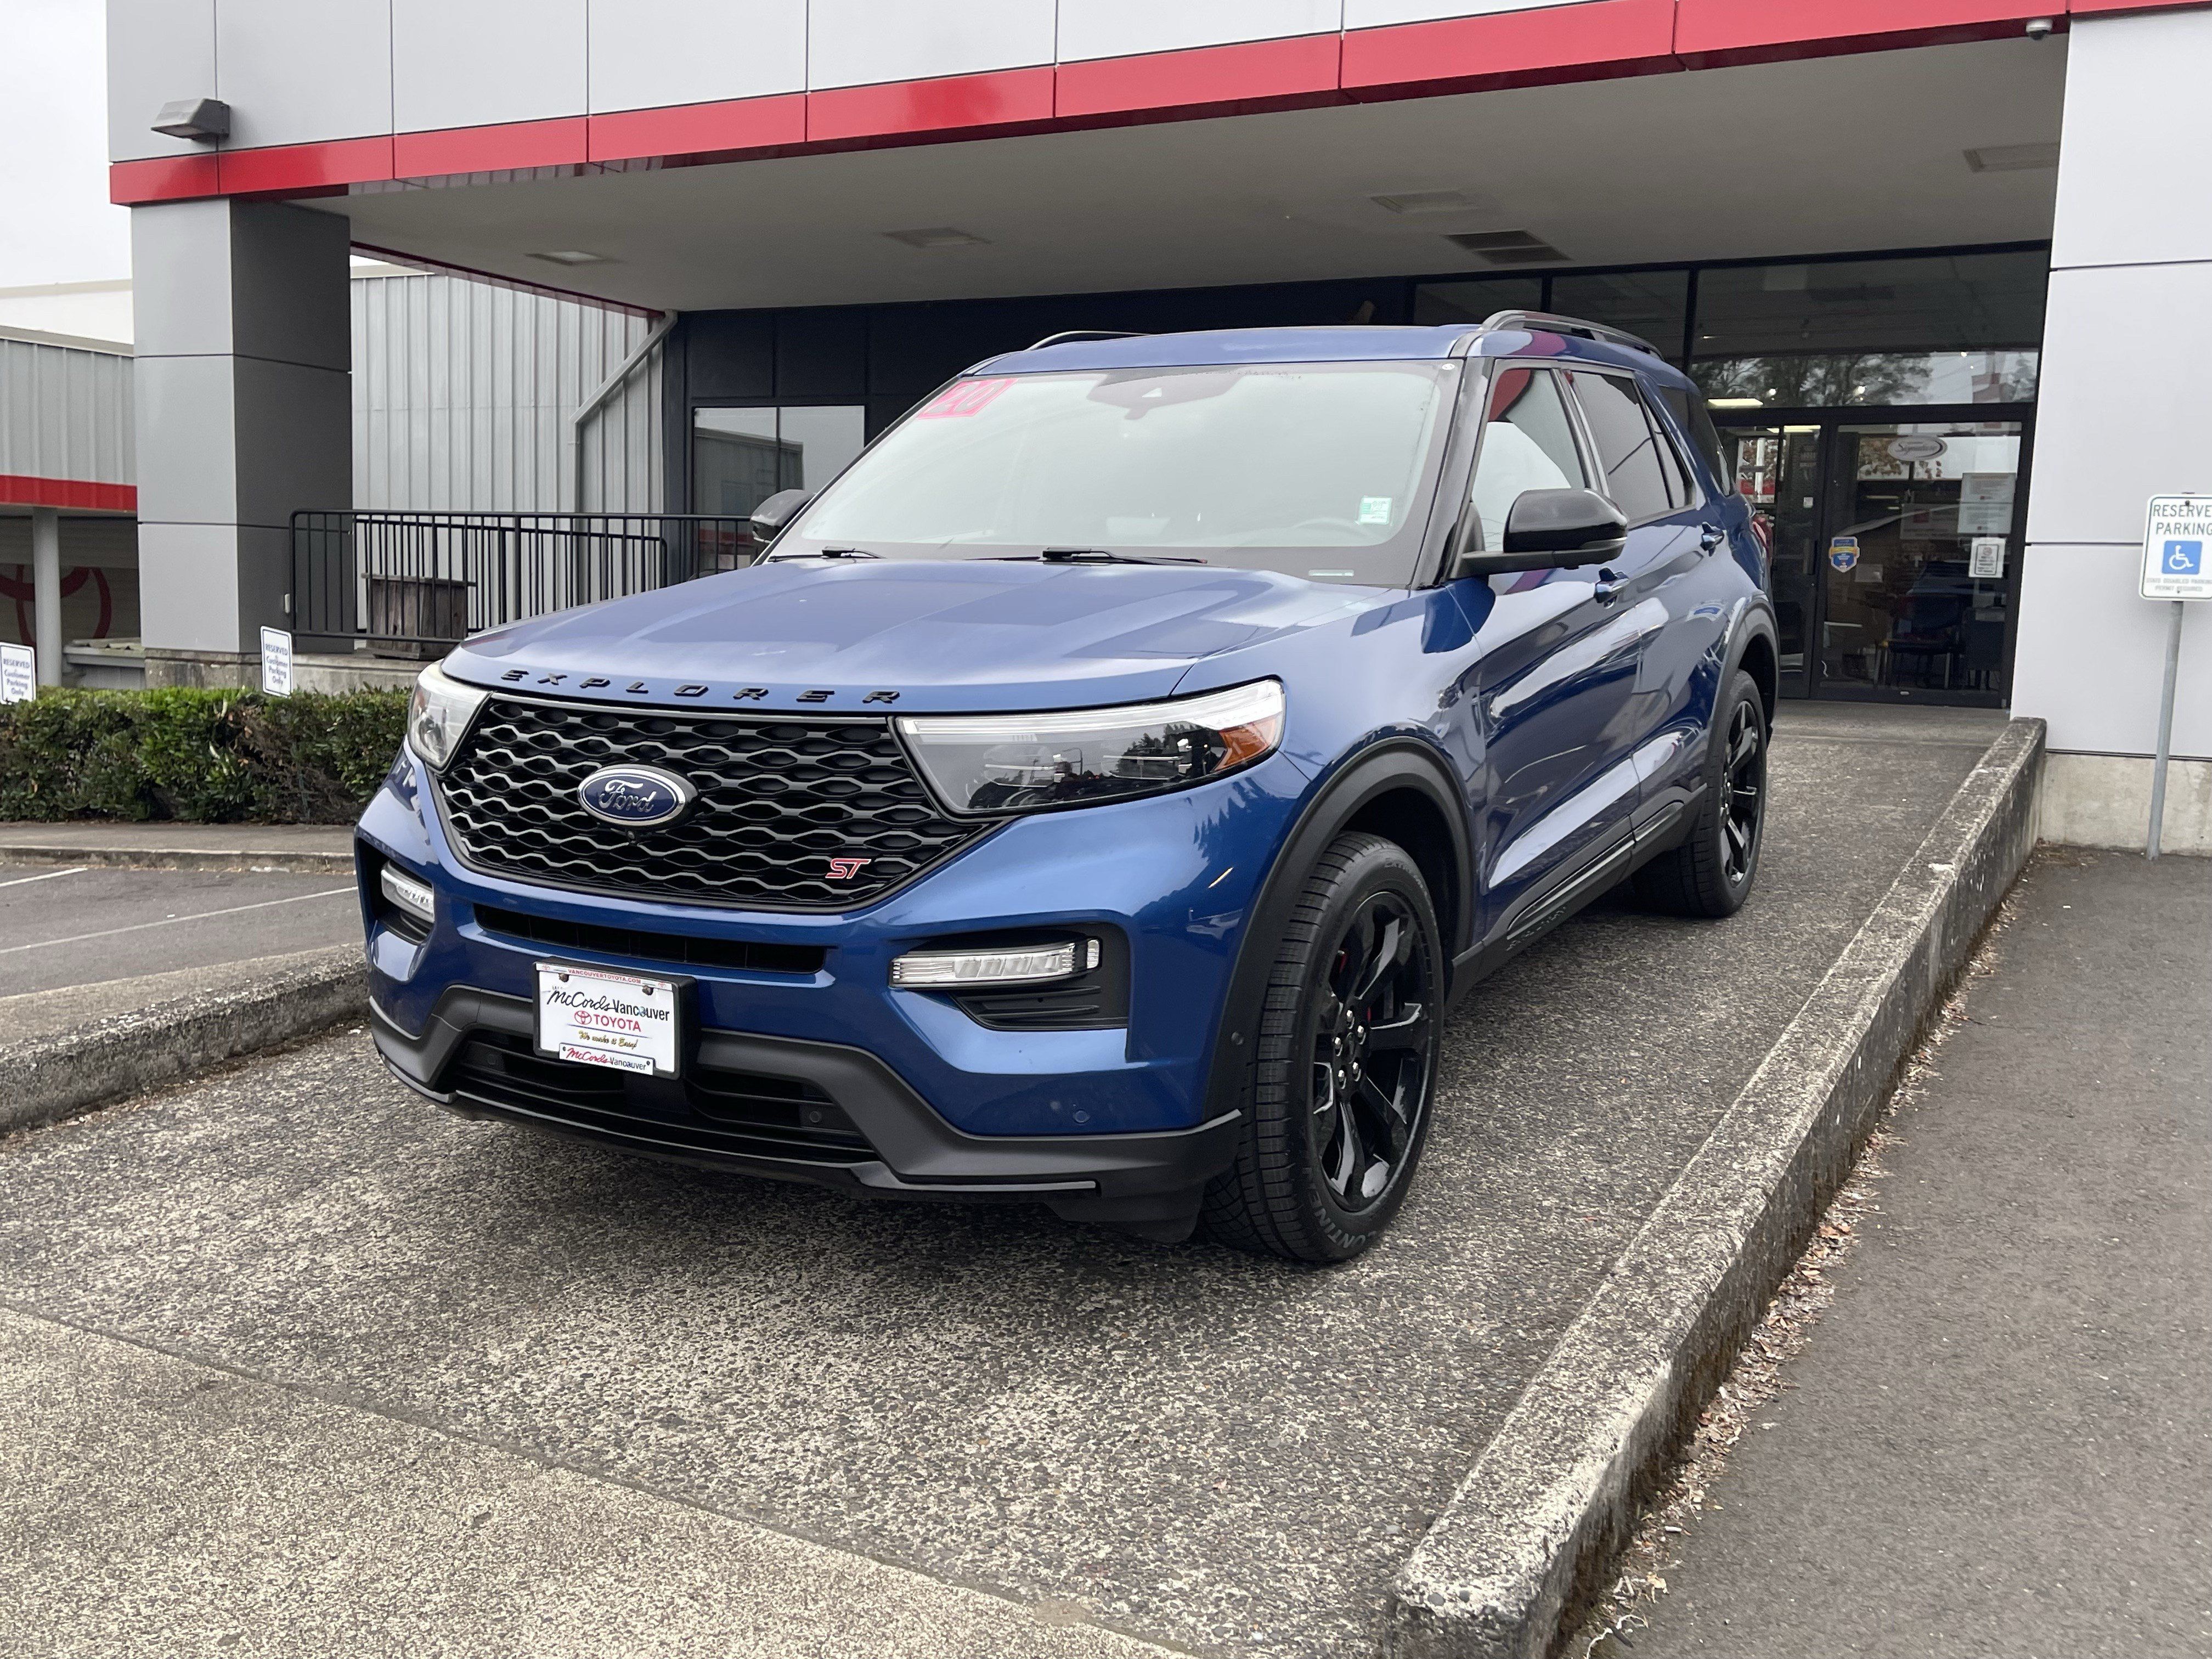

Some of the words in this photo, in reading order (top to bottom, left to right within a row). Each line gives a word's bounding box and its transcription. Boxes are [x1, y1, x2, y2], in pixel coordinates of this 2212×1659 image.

[2153, 504, 2212, 517] RESERVE
[266, 644, 288, 656] RESERVED
[3, 658, 30, 669] RESERVED
[500, 668, 901, 704] EXPLORER
[598, 779, 657, 813] Ford
[825, 857, 872, 879] ST
[593, 1014, 642, 1032] TOYOTA
